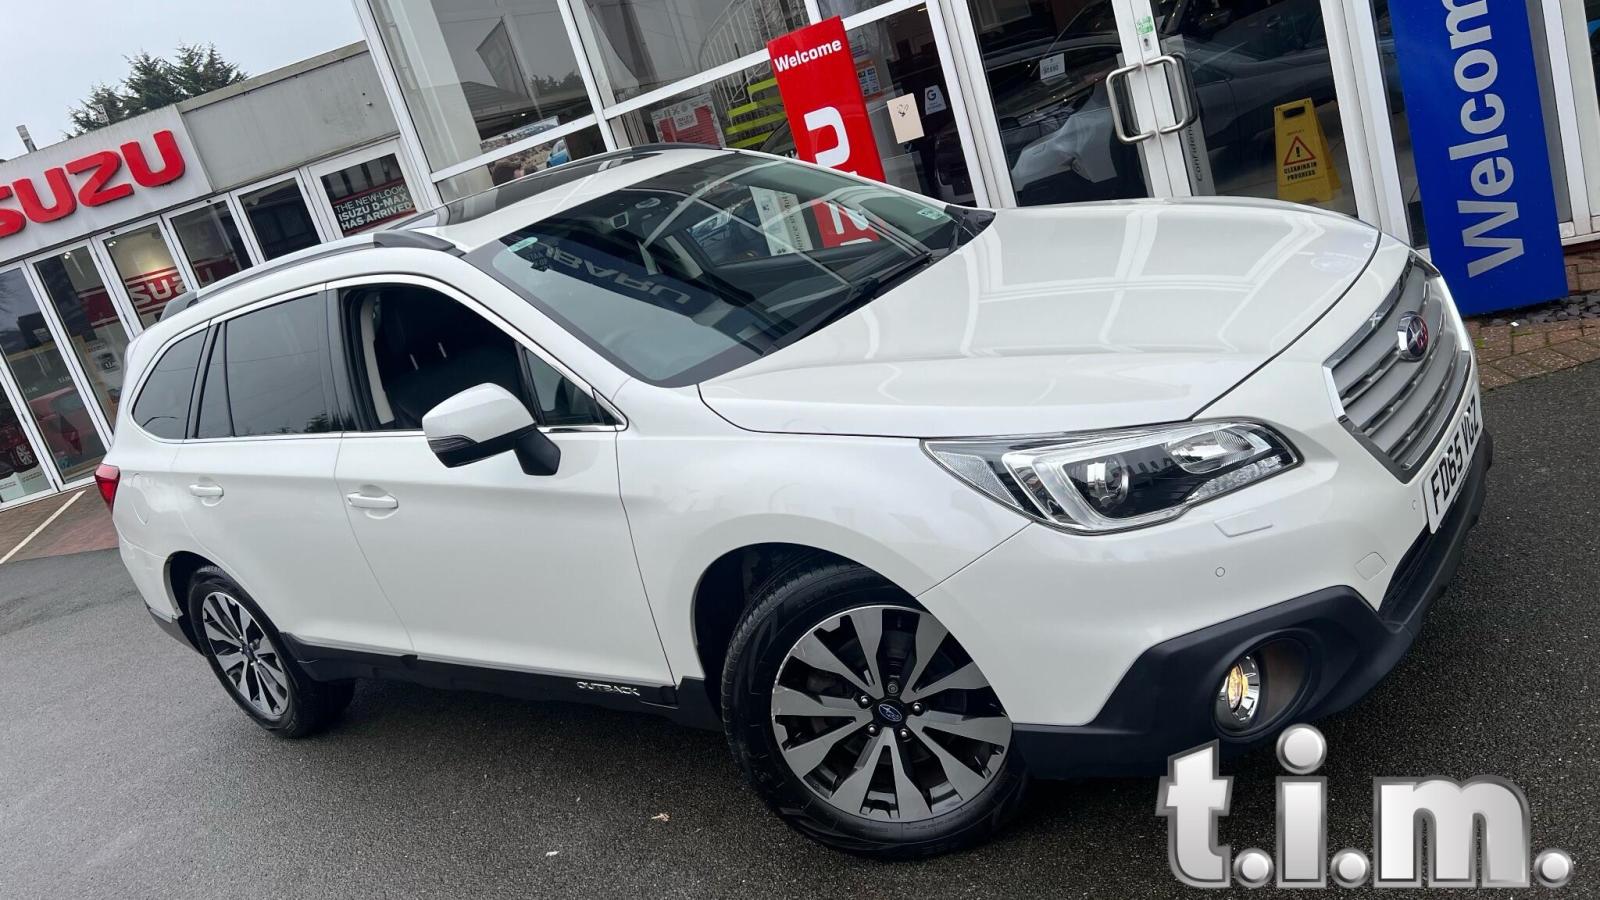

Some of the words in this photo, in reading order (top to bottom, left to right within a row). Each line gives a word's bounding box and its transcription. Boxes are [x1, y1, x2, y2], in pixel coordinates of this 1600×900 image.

[774, 39, 842, 73] Welcome
[334, 201, 354, 213] THE
[356, 185, 405, 206] NEW-LOOK
[338, 205, 370, 222] ISUZU
[372, 193, 409, 211] D-MAX
[341, 216, 365, 230] HAS
[365, 202, 412, 221] ARRIVED
[1430, 431, 1463, 515] FD65
[576, 681, 640, 696] OUTBACK
